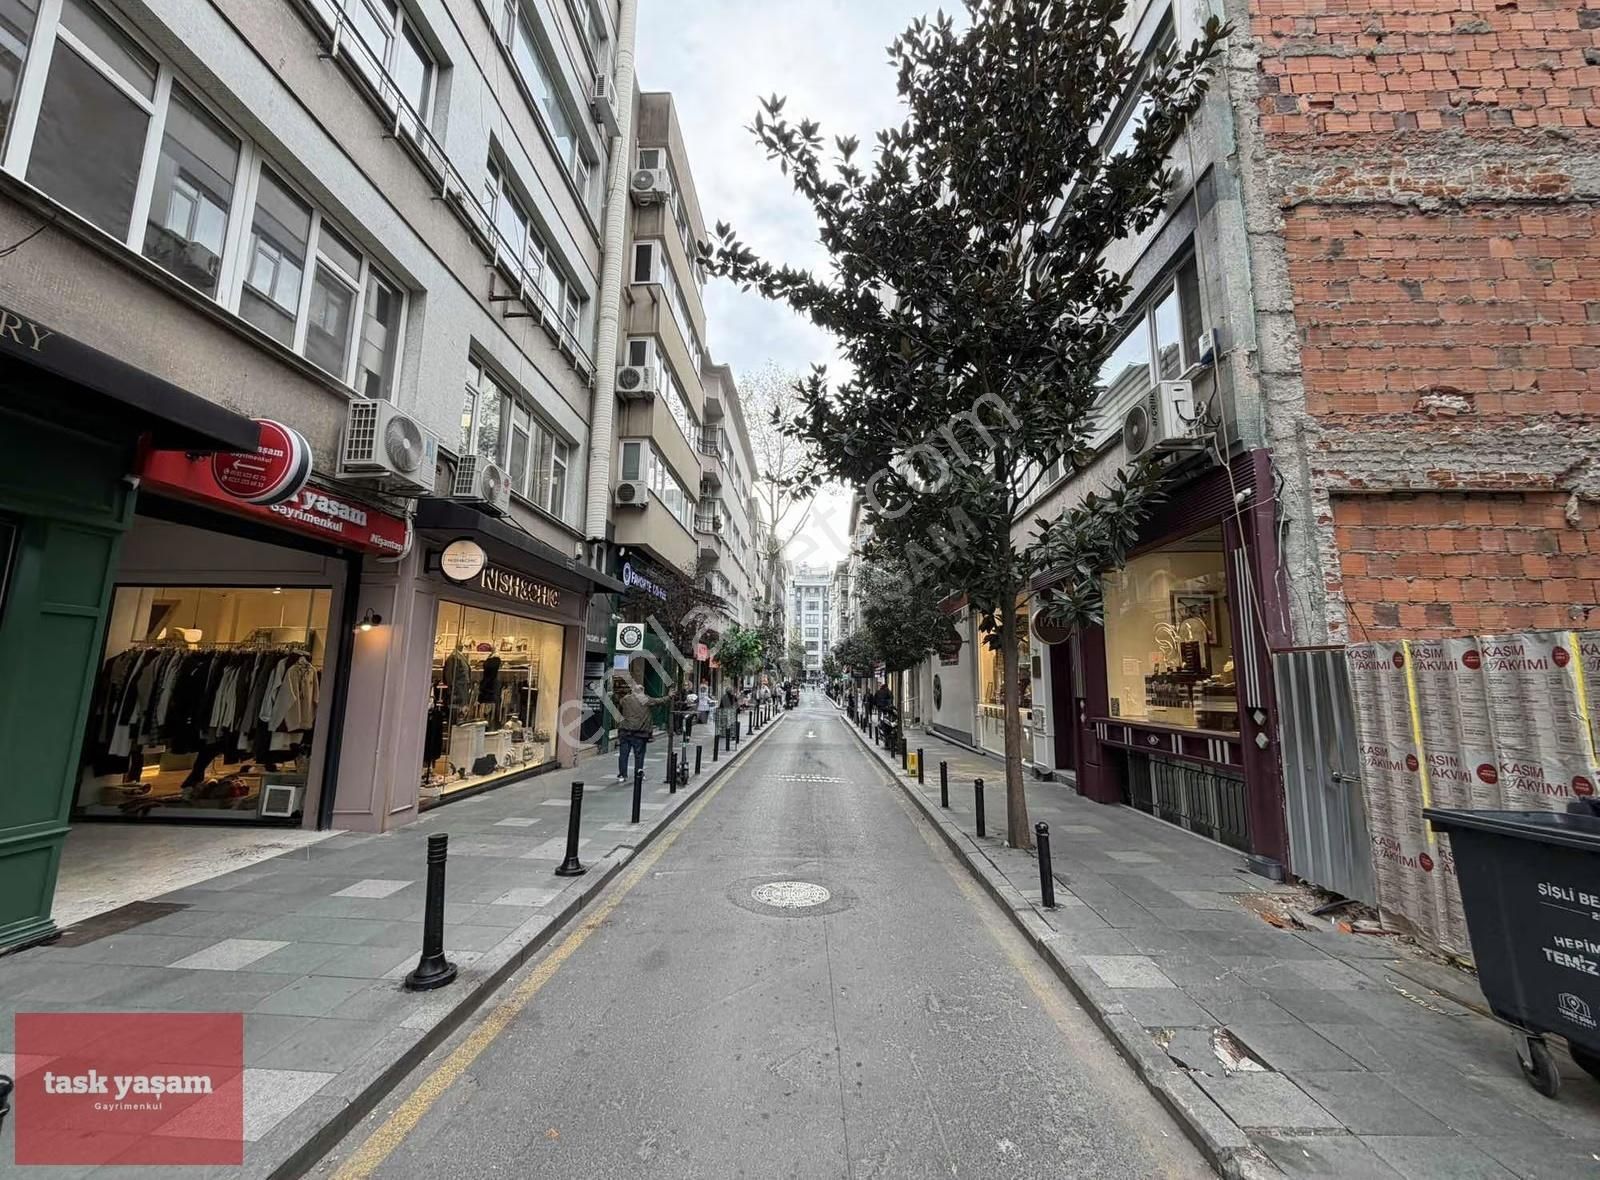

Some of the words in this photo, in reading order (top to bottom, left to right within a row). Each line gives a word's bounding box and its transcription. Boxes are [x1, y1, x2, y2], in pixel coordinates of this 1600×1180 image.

[301, 491, 367, 527] yaşam
[481, 567, 560, 608] NISH&CHIC
[1480, 644, 1525, 658] KASIM
[1499, 761, 1545, 779] KASIM
[1538, 882, 1575, 902] ŞİŞLİ
